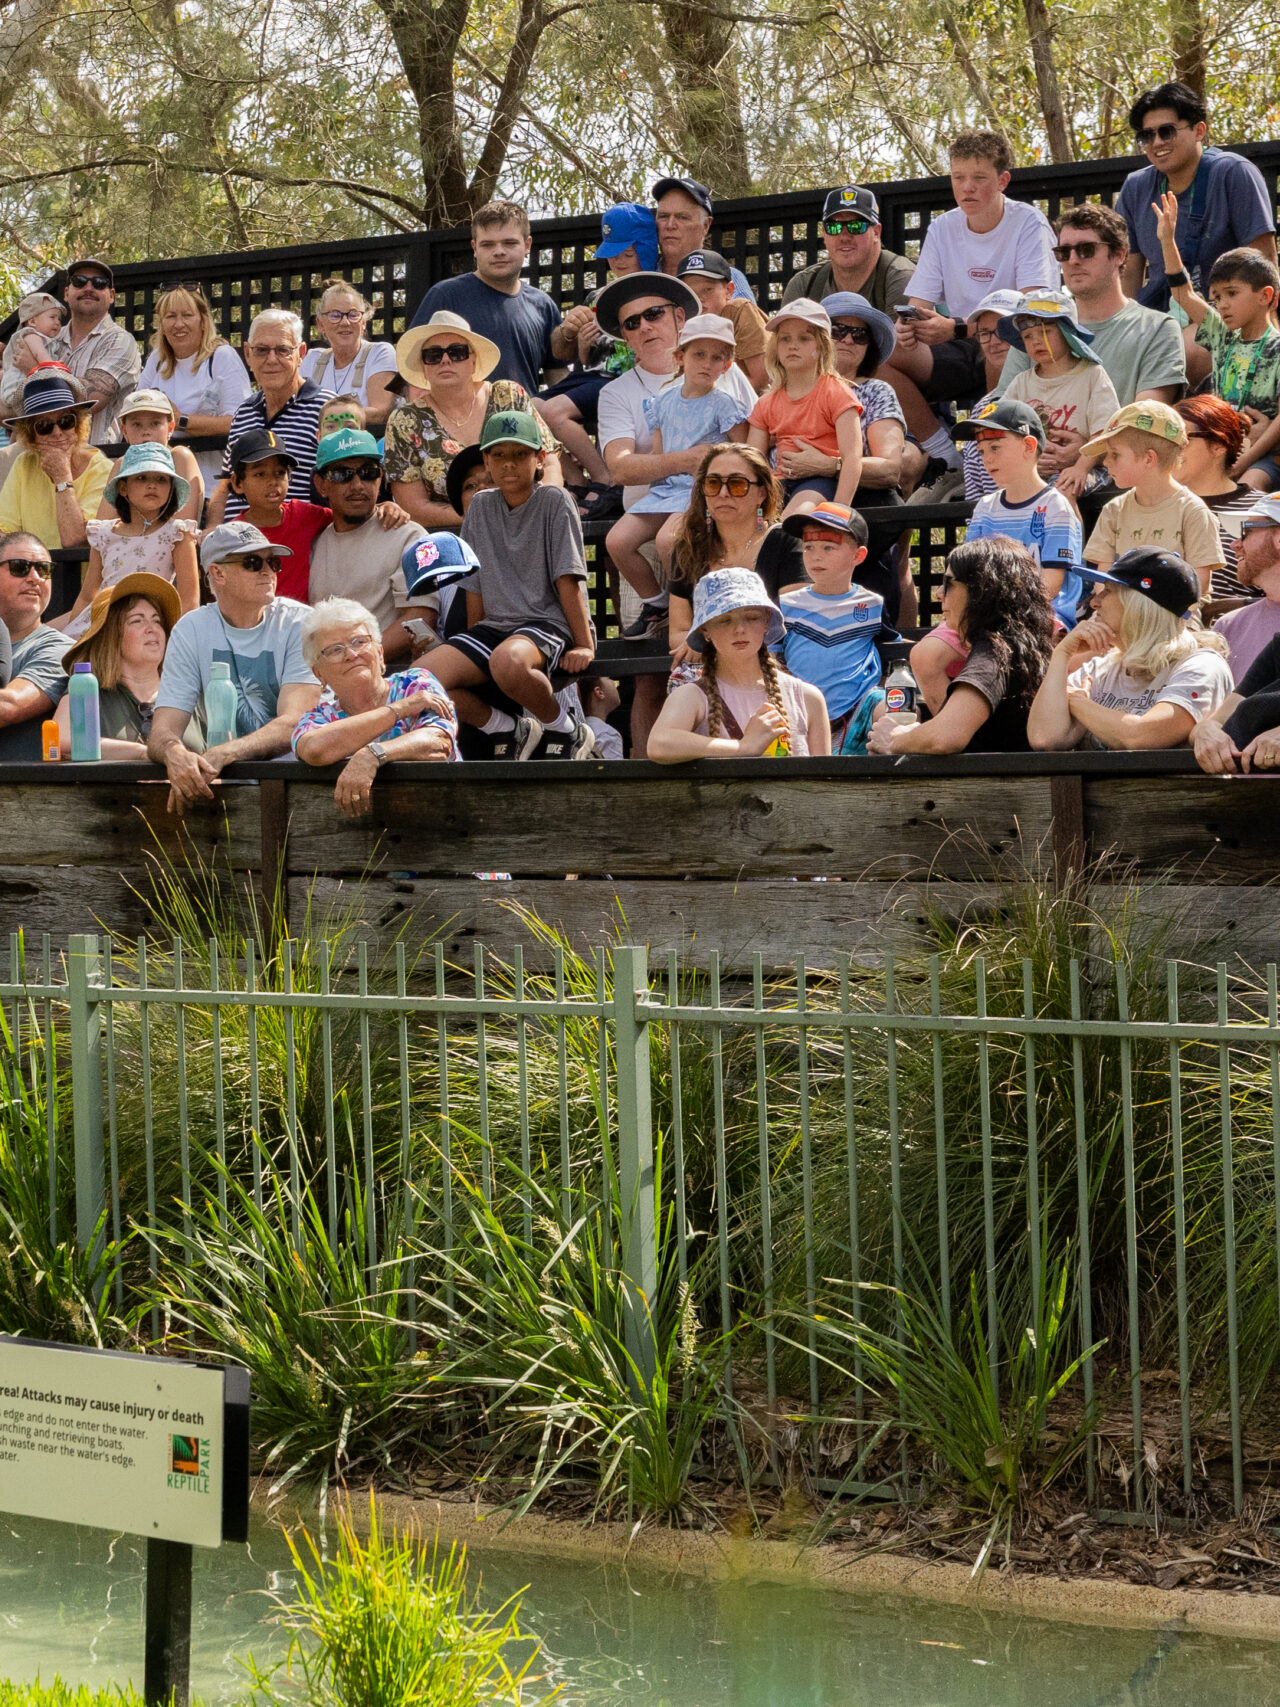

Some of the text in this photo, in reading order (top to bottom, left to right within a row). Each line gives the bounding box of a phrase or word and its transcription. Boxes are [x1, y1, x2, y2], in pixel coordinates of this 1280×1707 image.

[21, 1387, 62, 1405] Attacks
[64, 1396, 87, 1411] may
[90, 1399, 121, 1413] cause
[123, 1401, 155, 1421] injury
[157, 1409, 170, 1420] or
[172, 1409, 204, 1426] death
[3, 1409, 24, 1424] edge
[26, 1412, 43, 1424] and
[45, 1413, 57, 1425] do
[59, 1417, 74, 1428] not
[76, 1419, 100, 1432] enter
[102, 1422, 117, 1435] the
[119, 1427, 148, 1440] water.
[33, 1427, 51, 1439] and
[52, 1430, 95, 1450] retrieving
[97, 1437, 125, 1451] boats.
[9, 1438, 35, 1450] waste
[37, 1443, 58, 1454] near
[60, 1444, 75, 1457] the
[76, 1449, 110, 1463] water's
[111, 1454, 136, 1469] edge.
[199, 1438, 210, 1480] PARK
[166, 1473, 210, 1494] REPTILE
